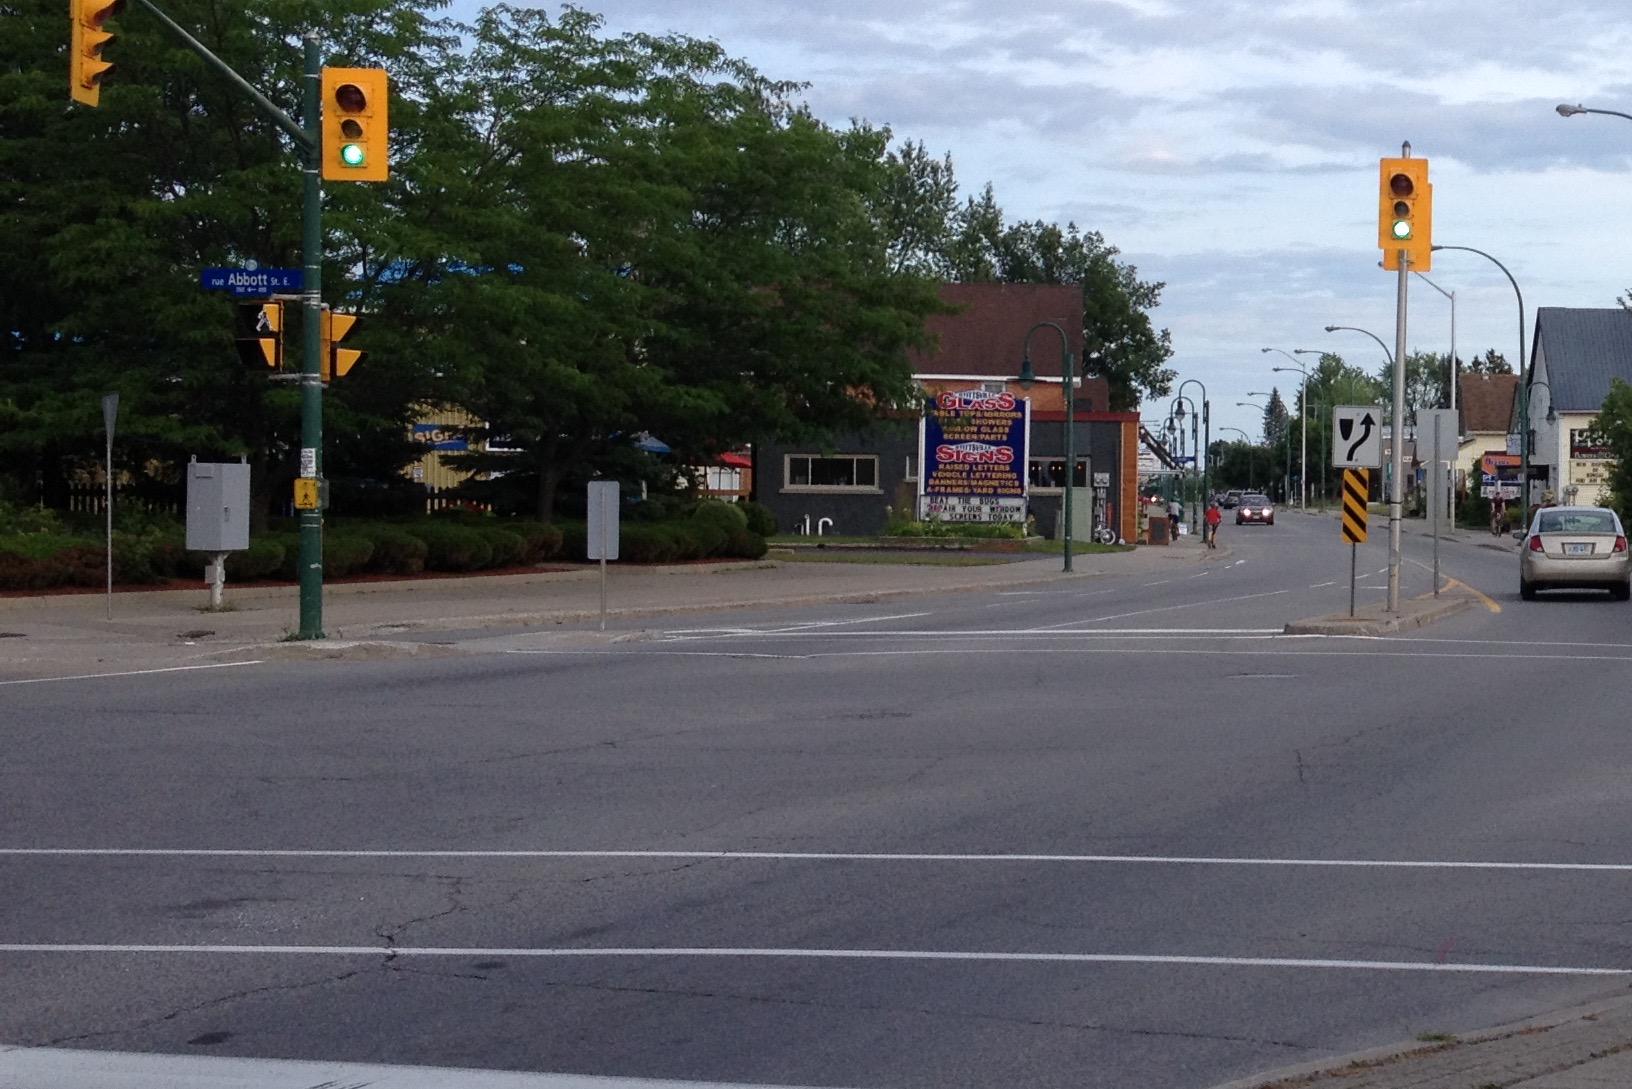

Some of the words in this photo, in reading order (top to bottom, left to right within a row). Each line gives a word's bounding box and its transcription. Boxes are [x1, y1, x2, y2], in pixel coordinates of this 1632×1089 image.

[228, 272, 268, 286] Abbott
[937, 391, 1016, 410] GLASS
[936, 445, 1014, 463] SIGNS
[958, 497, 971, 505] THE
